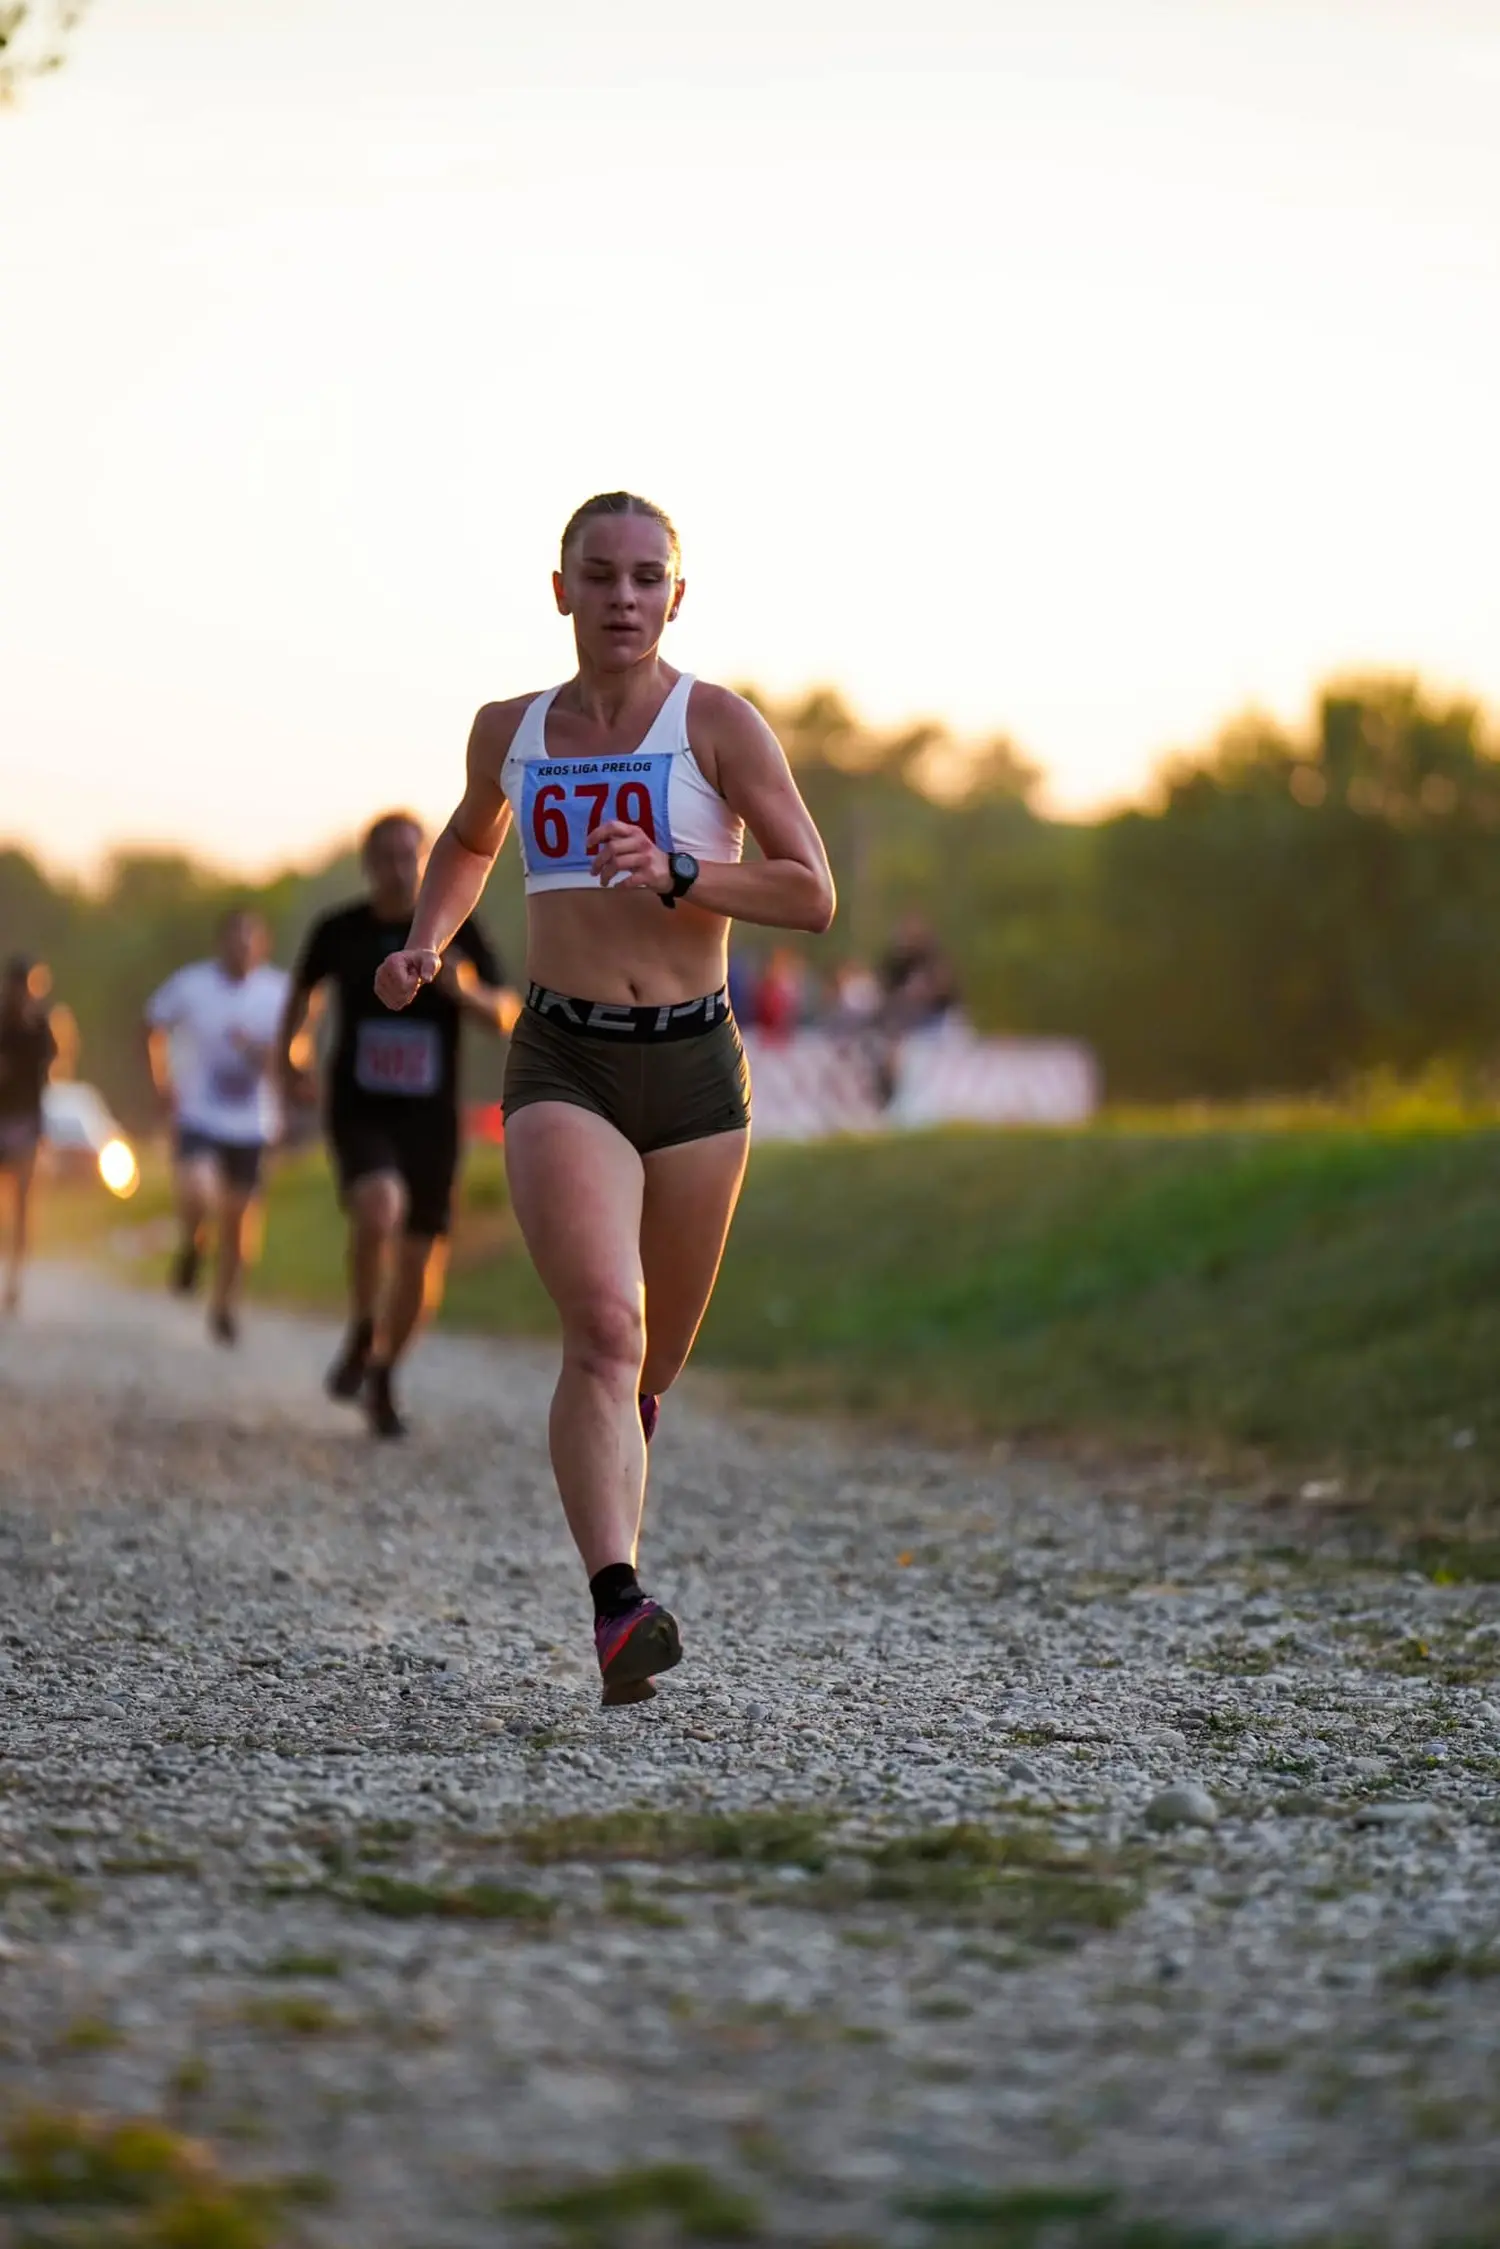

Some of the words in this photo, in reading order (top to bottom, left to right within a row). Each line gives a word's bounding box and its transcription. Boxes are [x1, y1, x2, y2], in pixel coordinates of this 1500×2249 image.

[538, 765, 569, 776] KROS
[572, 763, 599, 774] LIGA
[602, 761, 652, 773] PRELOG
[533, 781, 657, 859] 679
